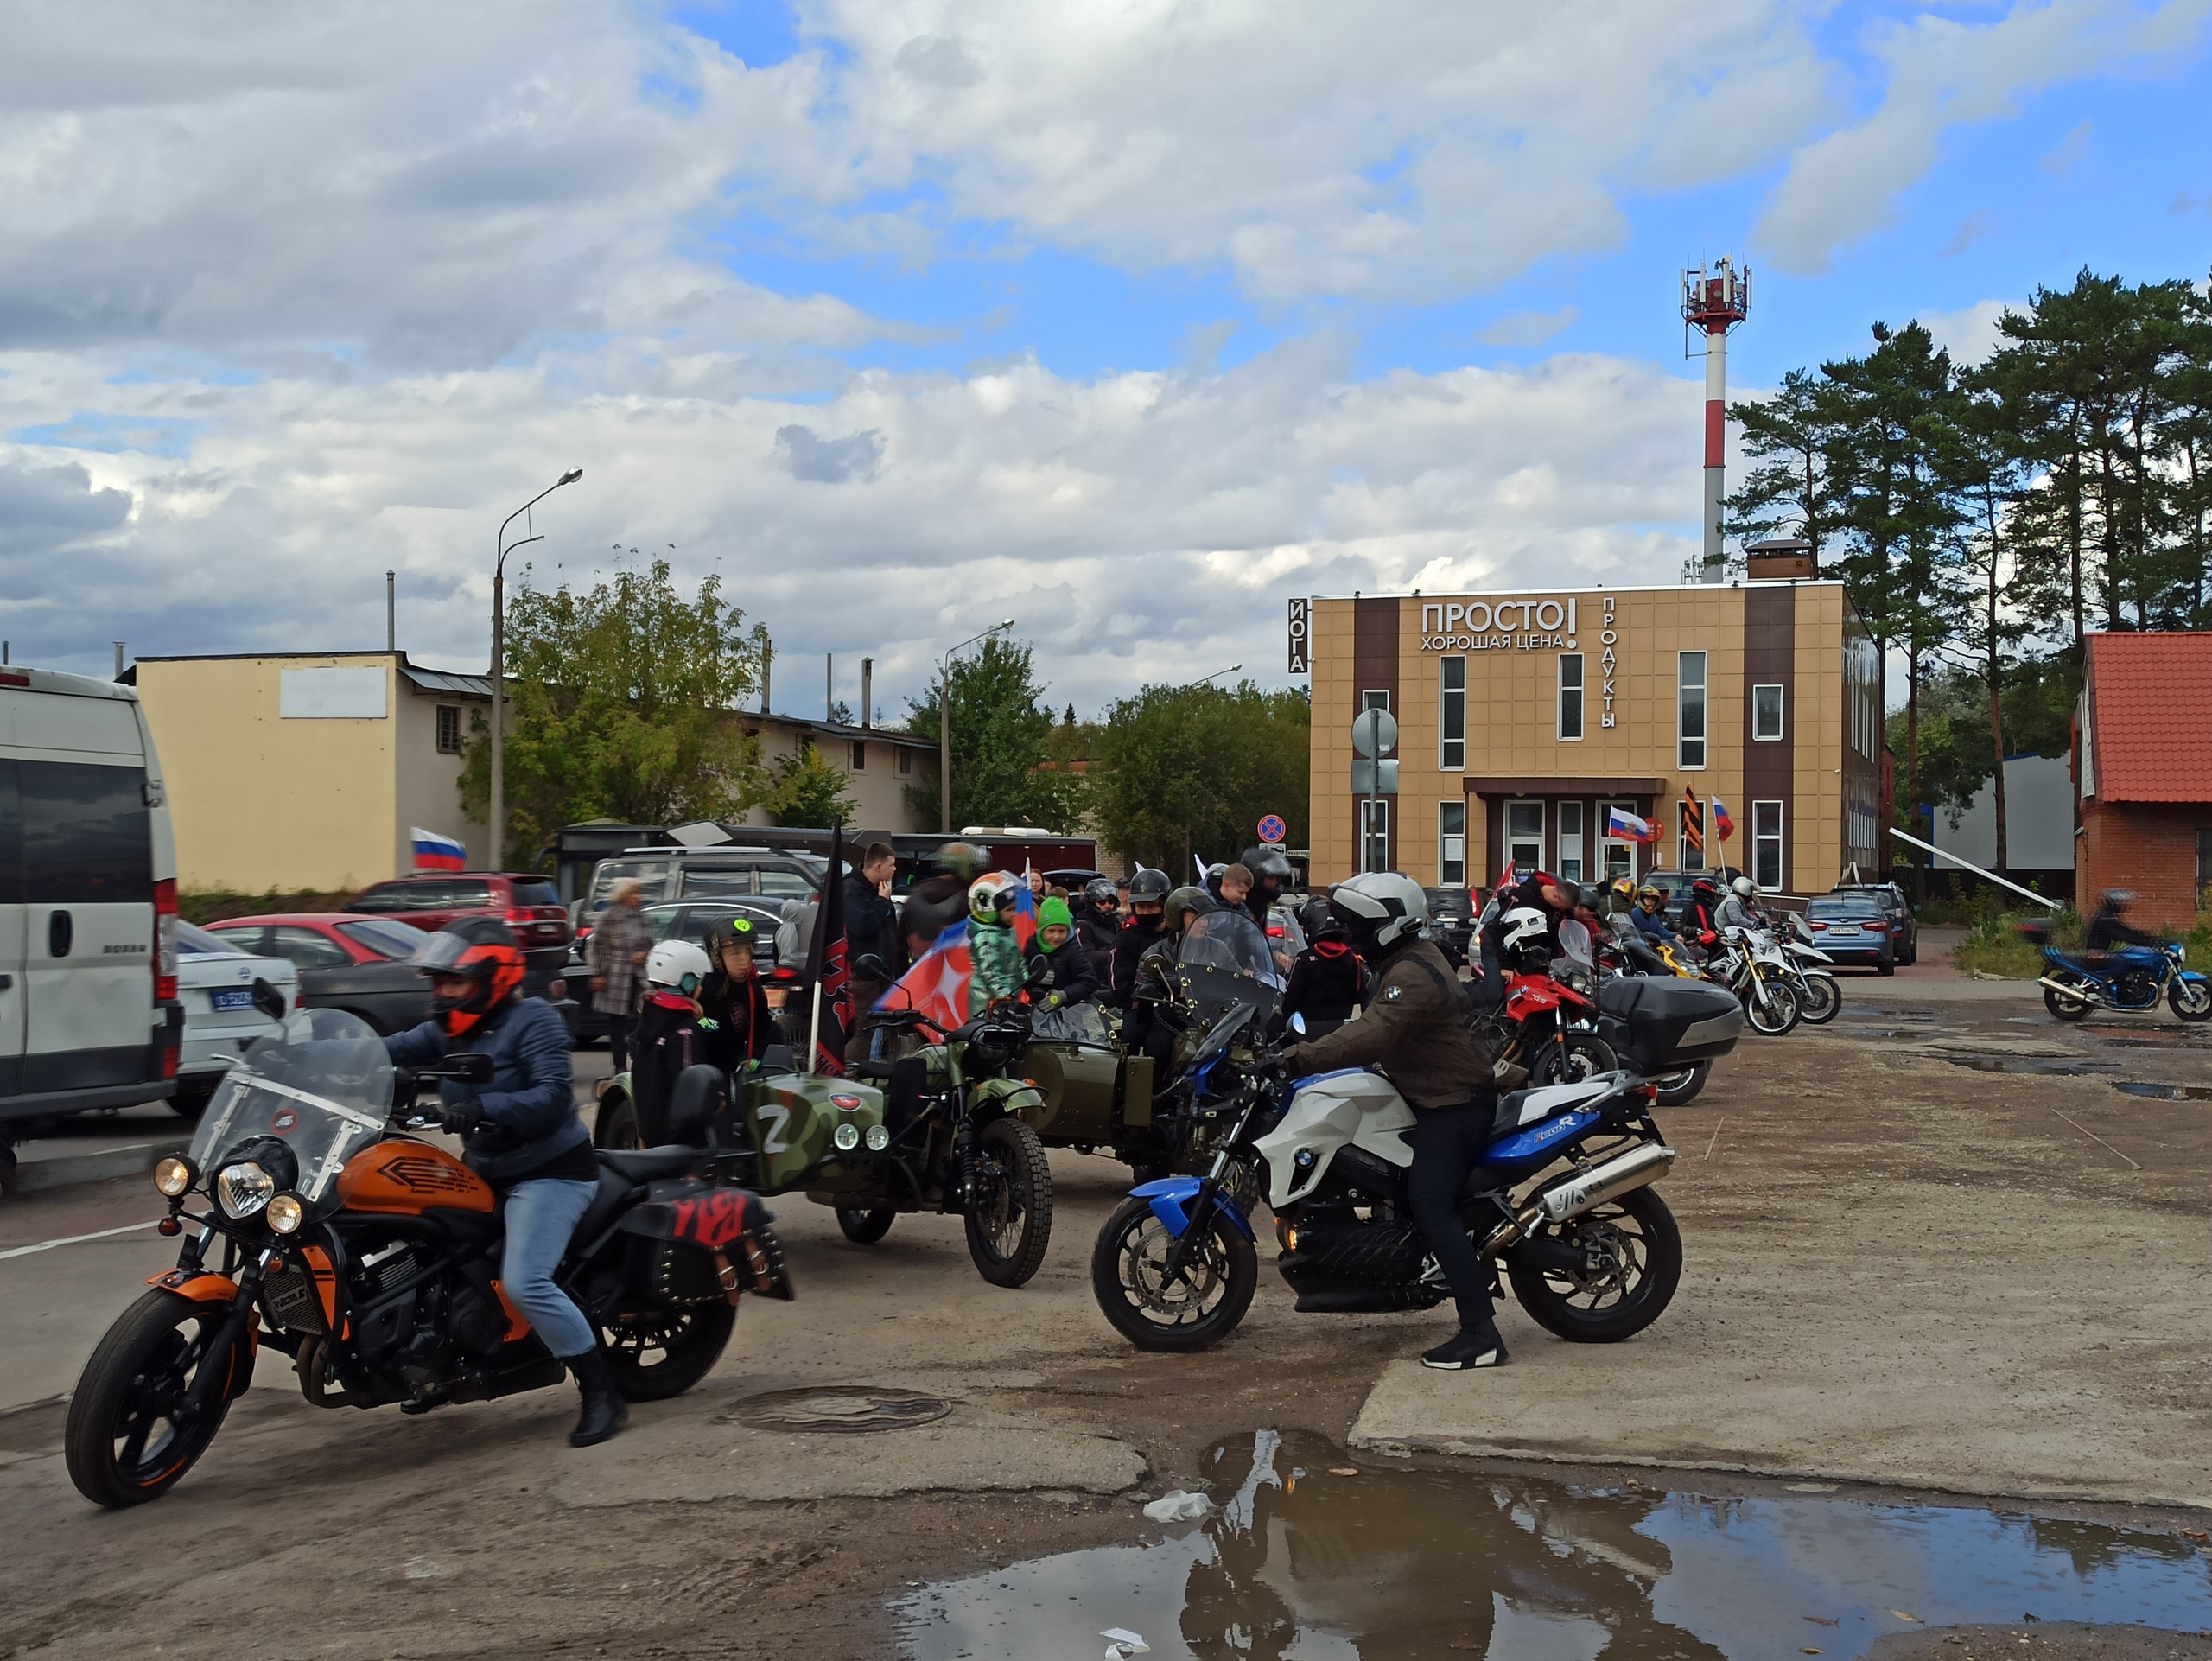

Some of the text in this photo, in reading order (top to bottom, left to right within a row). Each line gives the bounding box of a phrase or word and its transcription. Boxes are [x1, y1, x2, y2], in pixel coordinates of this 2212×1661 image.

[1289, 599, 1306, 672] ЙОГА
[1421, 598, 1577, 649] ПРОСТО!
[1421, 633, 1565, 651] ХОРОШАЯ ЦЕНА
[1600, 597, 1617, 728] ПРОДУКТЫ
[103, 945, 147, 954] BOXER
